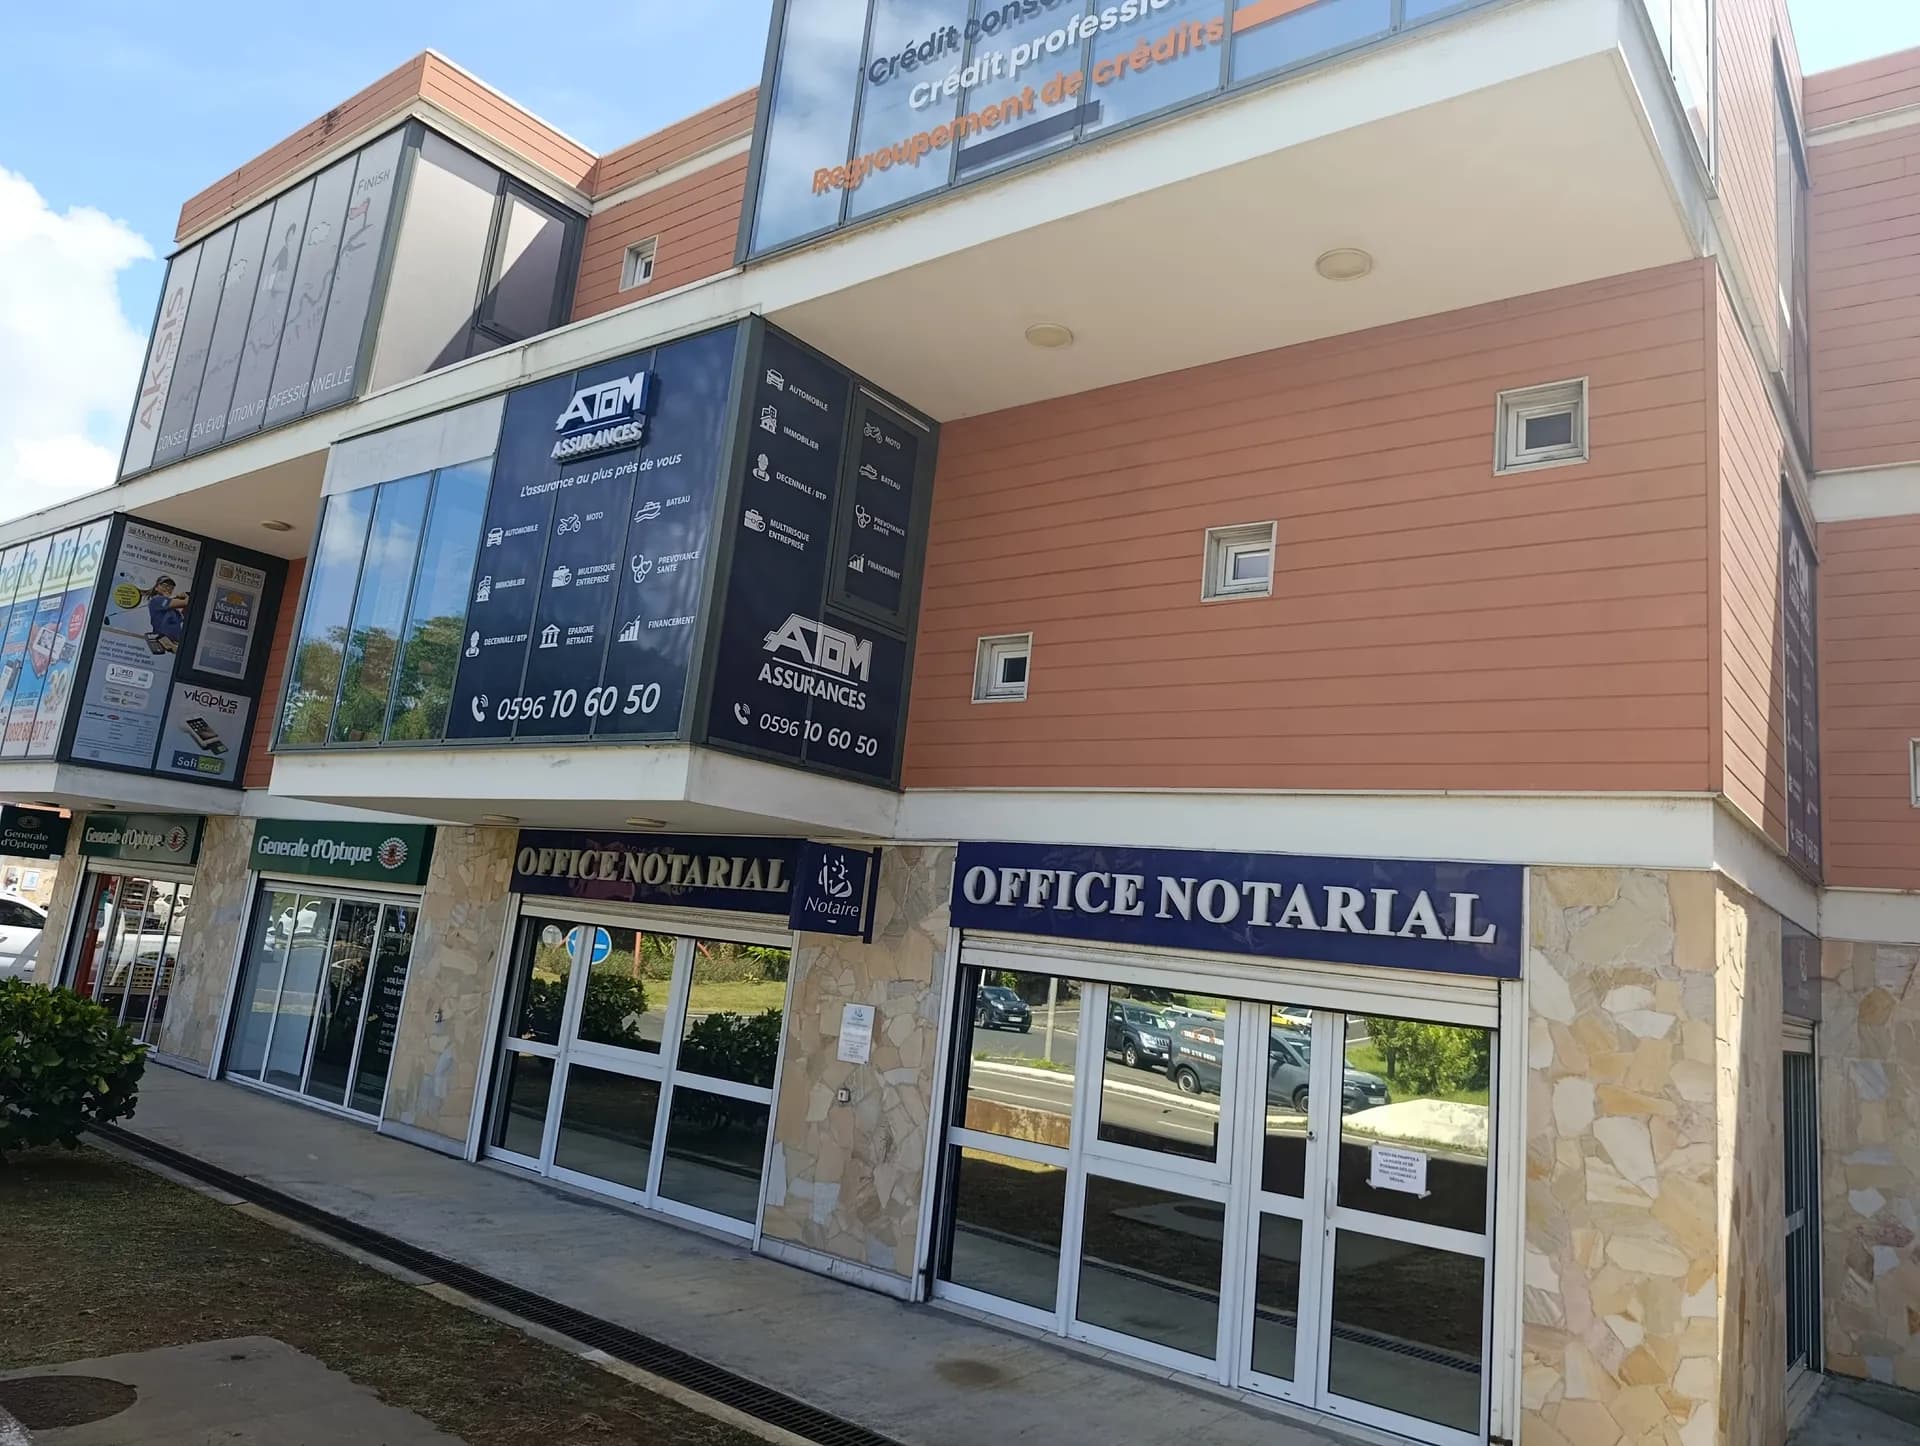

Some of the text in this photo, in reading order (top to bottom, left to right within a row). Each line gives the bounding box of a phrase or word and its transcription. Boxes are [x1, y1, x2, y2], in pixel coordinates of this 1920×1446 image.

[868, 25, 957, 83] Crédit
[909, 52, 1004, 109] Crédit
[811, 86, 1037, 194] Regroupement
[1039, 70, 1083, 105] de
[357, 168, 391, 196] FINISH
[157, 431, 189, 451] CONSEIL
[191, 423, 204, 439] EN
[256, 366, 353, 416] PROFESSIONNELLE
[555, 371, 645, 430] ATOM
[789, 384, 829, 412] AUTOMOBILE
[551, 420, 643, 458] ASSURANCES
[784, 425, 819, 450] IMMOBILIER
[885, 435, 901, 449] MOTO
[520, 454, 682, 498] L'assurance au plus près de vous
[776, 471, 812, 496] DECENNALE
[815, 490, 827, 501] BTP
[880, 475, 901, 491] BATEAU
[666, 495, 691, 507] BATEAU
[585, 511, 604, 522] MOTO
[504, 523, 539, 538] AUTOMOBILE
[768, 530, 804, 551] ENTREPRISE
[769, 519, 810, 542] MULTIRISQUE
[575, 575, 610, 587] ENTREPRISE
[577, 563, 616, 576] MULTIRISQUE
[867, 559, 900, 580] FINANCEMENT
[494, 578, 526, 589] IMMOBILIER
[214, 611, 246, 627] Vision
[567, 625, 594, 635] EPARGNE
[648, 616, 696, 629] FINANCEMENT
[566, 635, 593, 646] RETRAITE
[763, 612, 873, 682] ATOM
[757, 663, 866, 710] ASSURANCES
[184, 690, 238, 710] vit@plus
[497, 683, 661, 721] 0596 10 60 50
[759, 713, 878, 757] 0596 10 60 50
[1, 838, 48, 852] d'Optique
[258, 835, 373, 866] Generale d'Optique
[517, 847, 790, 893] OFFICE NOTARIAL
[804, 896, 859, 918] Notaire
[962, 865, 1498, 945] OFFICE NOTARIAL
